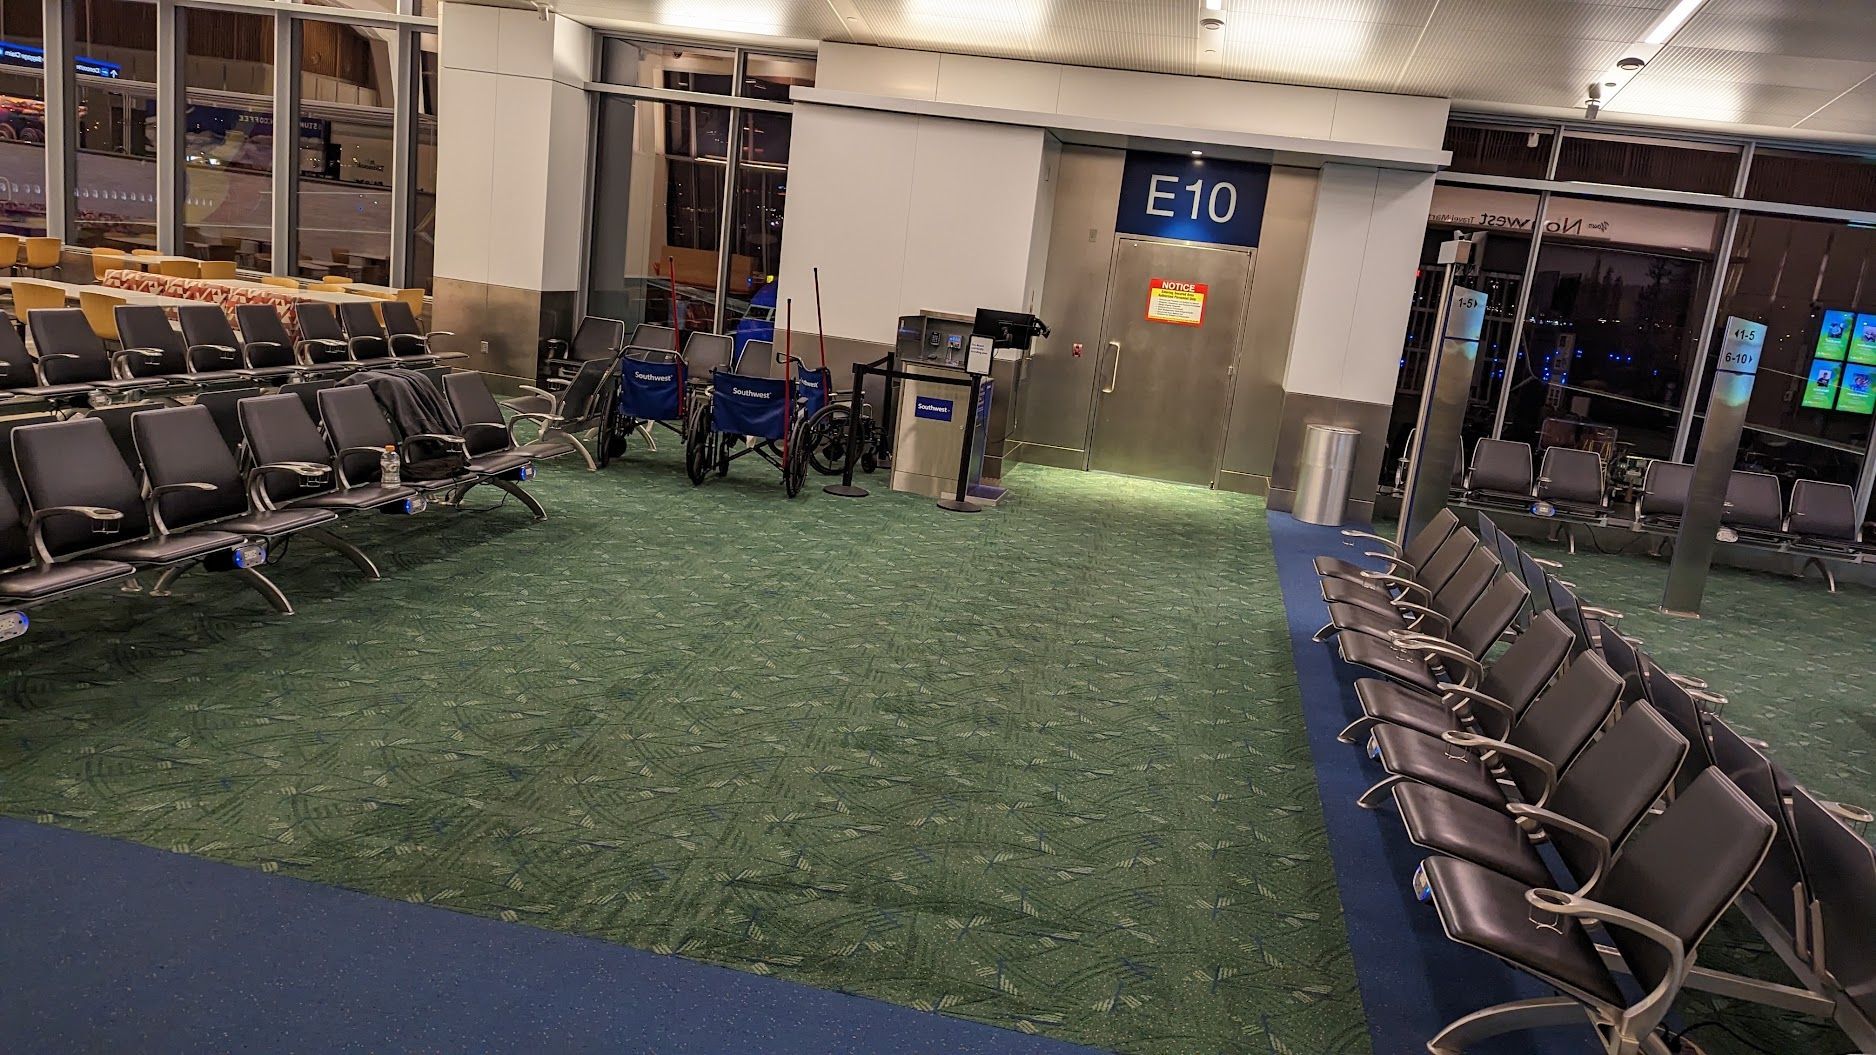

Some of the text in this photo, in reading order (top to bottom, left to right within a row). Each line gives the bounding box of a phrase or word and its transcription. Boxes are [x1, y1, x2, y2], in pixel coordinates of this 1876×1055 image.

[1146, 174, 1237, 224] E10
[1162, 281, 1196, 293] NOTICE
[1458, 297, 1473, 309] 1-5
[1740, 329, 1756, 341] 1-5
[1725, 352, 1748, 364] 6-10
[635, 371, 672, 382] Southwest
[732, 387, 771, 399] Southwest
[917, 403, 948, 413] Southwest
